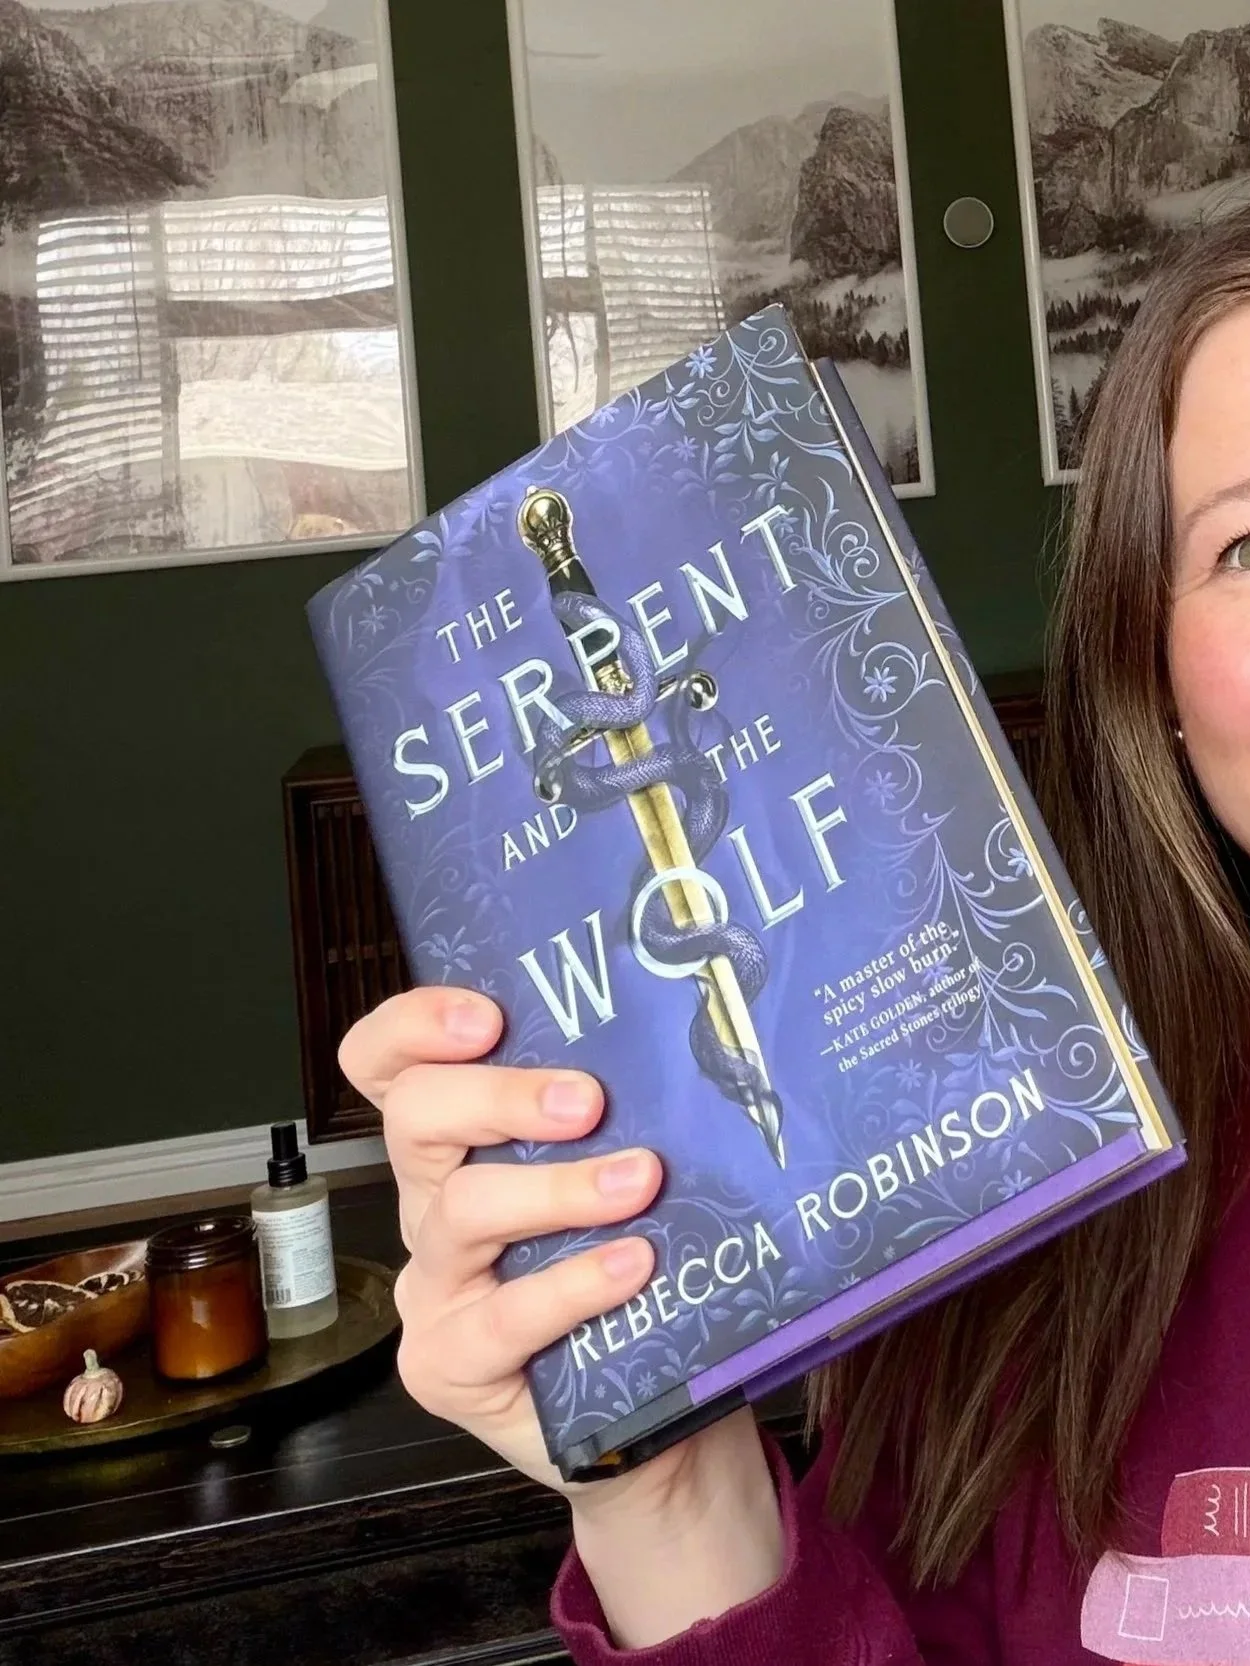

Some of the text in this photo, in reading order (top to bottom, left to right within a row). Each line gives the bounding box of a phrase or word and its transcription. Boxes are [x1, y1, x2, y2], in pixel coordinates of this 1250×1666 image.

[391, 504, 804, 821] SERPENT
[436, 587, 524, 664] THE
[501, 713, 784, 872] AND THE
[518, 771, 849, 1045] WOLF
[823, 991, 866, 1026] spicy
[870, 967, 907, 998] slow
[839, 950, 896, 993] master
[899, 933, 918, 958] of
[919, 921, 949, 945] the
[870, 991, 928, 1030] GOLDEN,
[929, 969, 967, 997] author
[968, 955, 982, 973] of
[838, 981, 983, 1072] the Sacred Stones trilogy
[568, 1068, 1047, 1371] REBECCA ROBINSON
